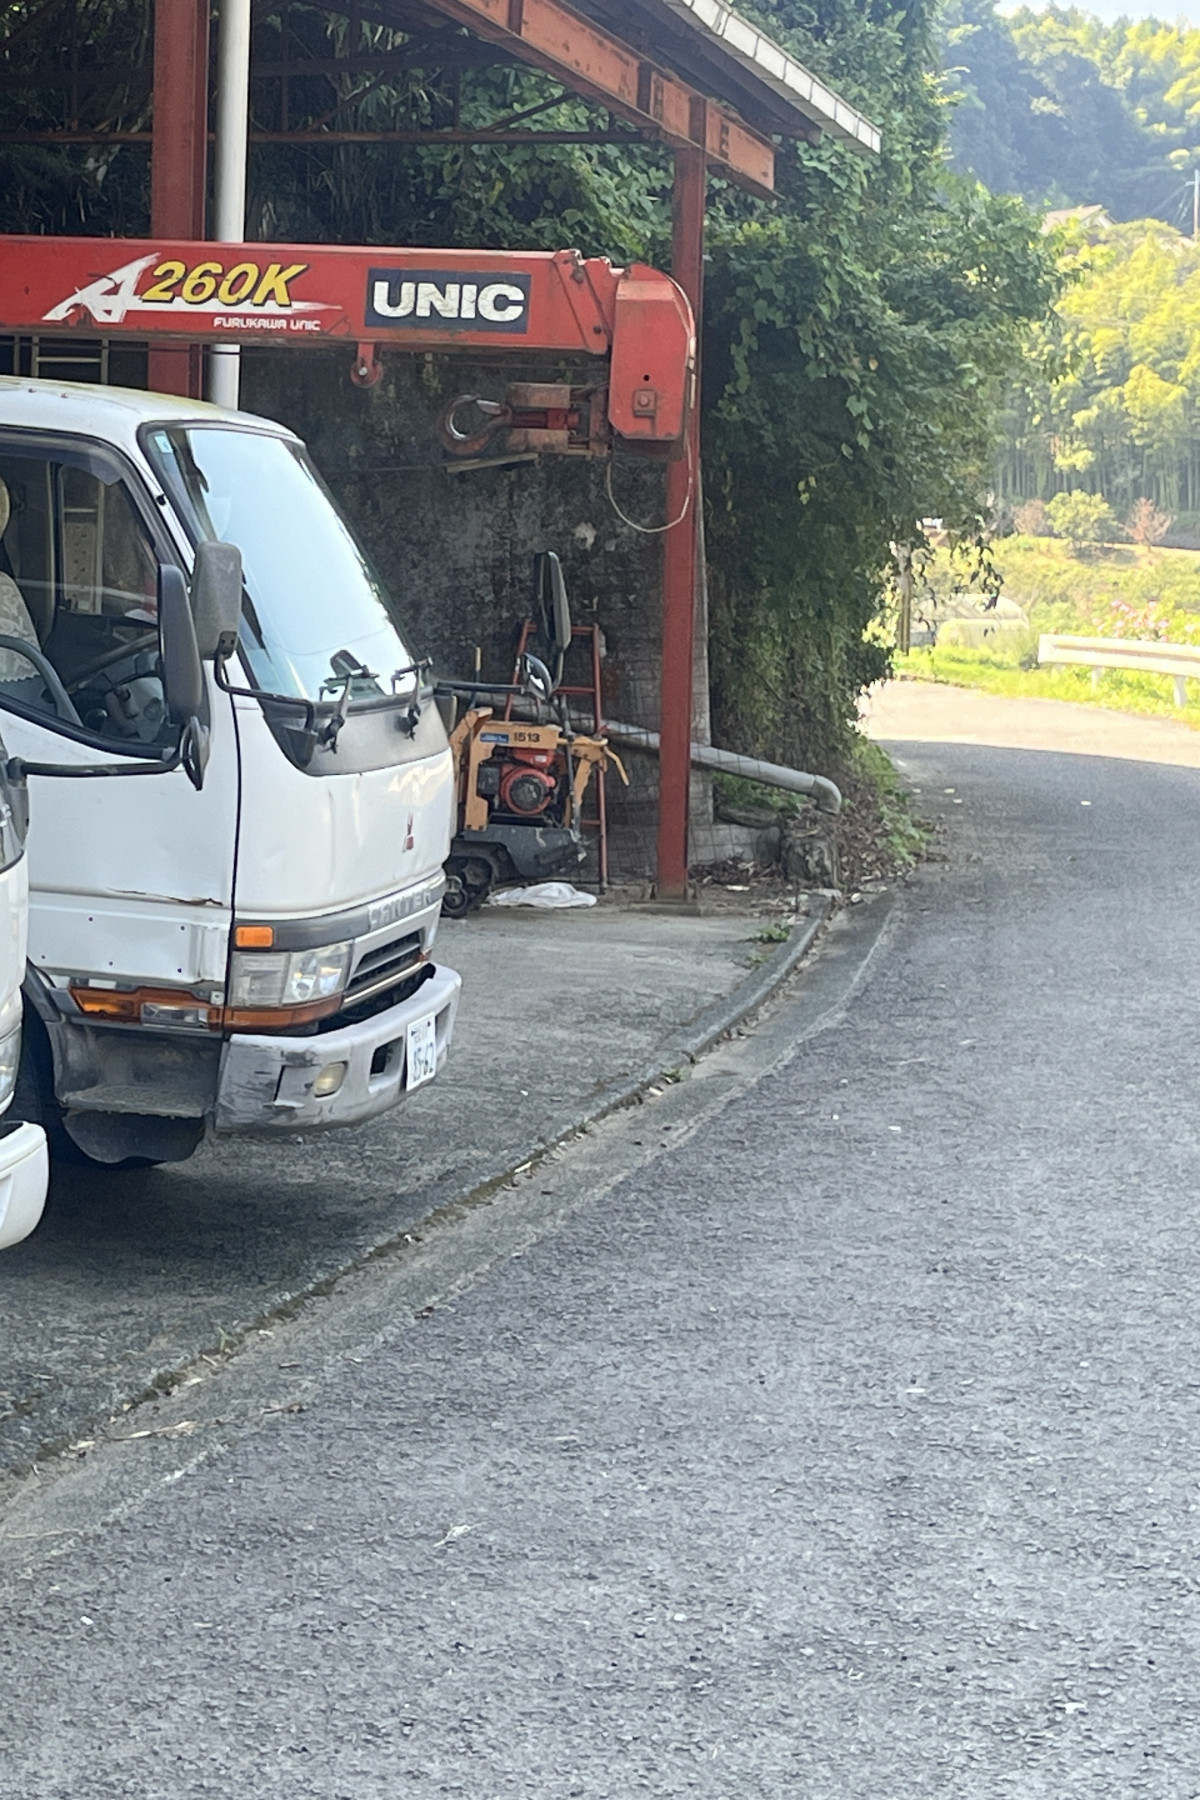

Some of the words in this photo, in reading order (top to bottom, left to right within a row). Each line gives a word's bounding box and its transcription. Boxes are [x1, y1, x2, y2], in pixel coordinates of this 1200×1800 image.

[140, 260, 309, 307] 260K
[373, 281, 525, 322] UNIC
[213, 316, 288, 331] FURUKAWA
